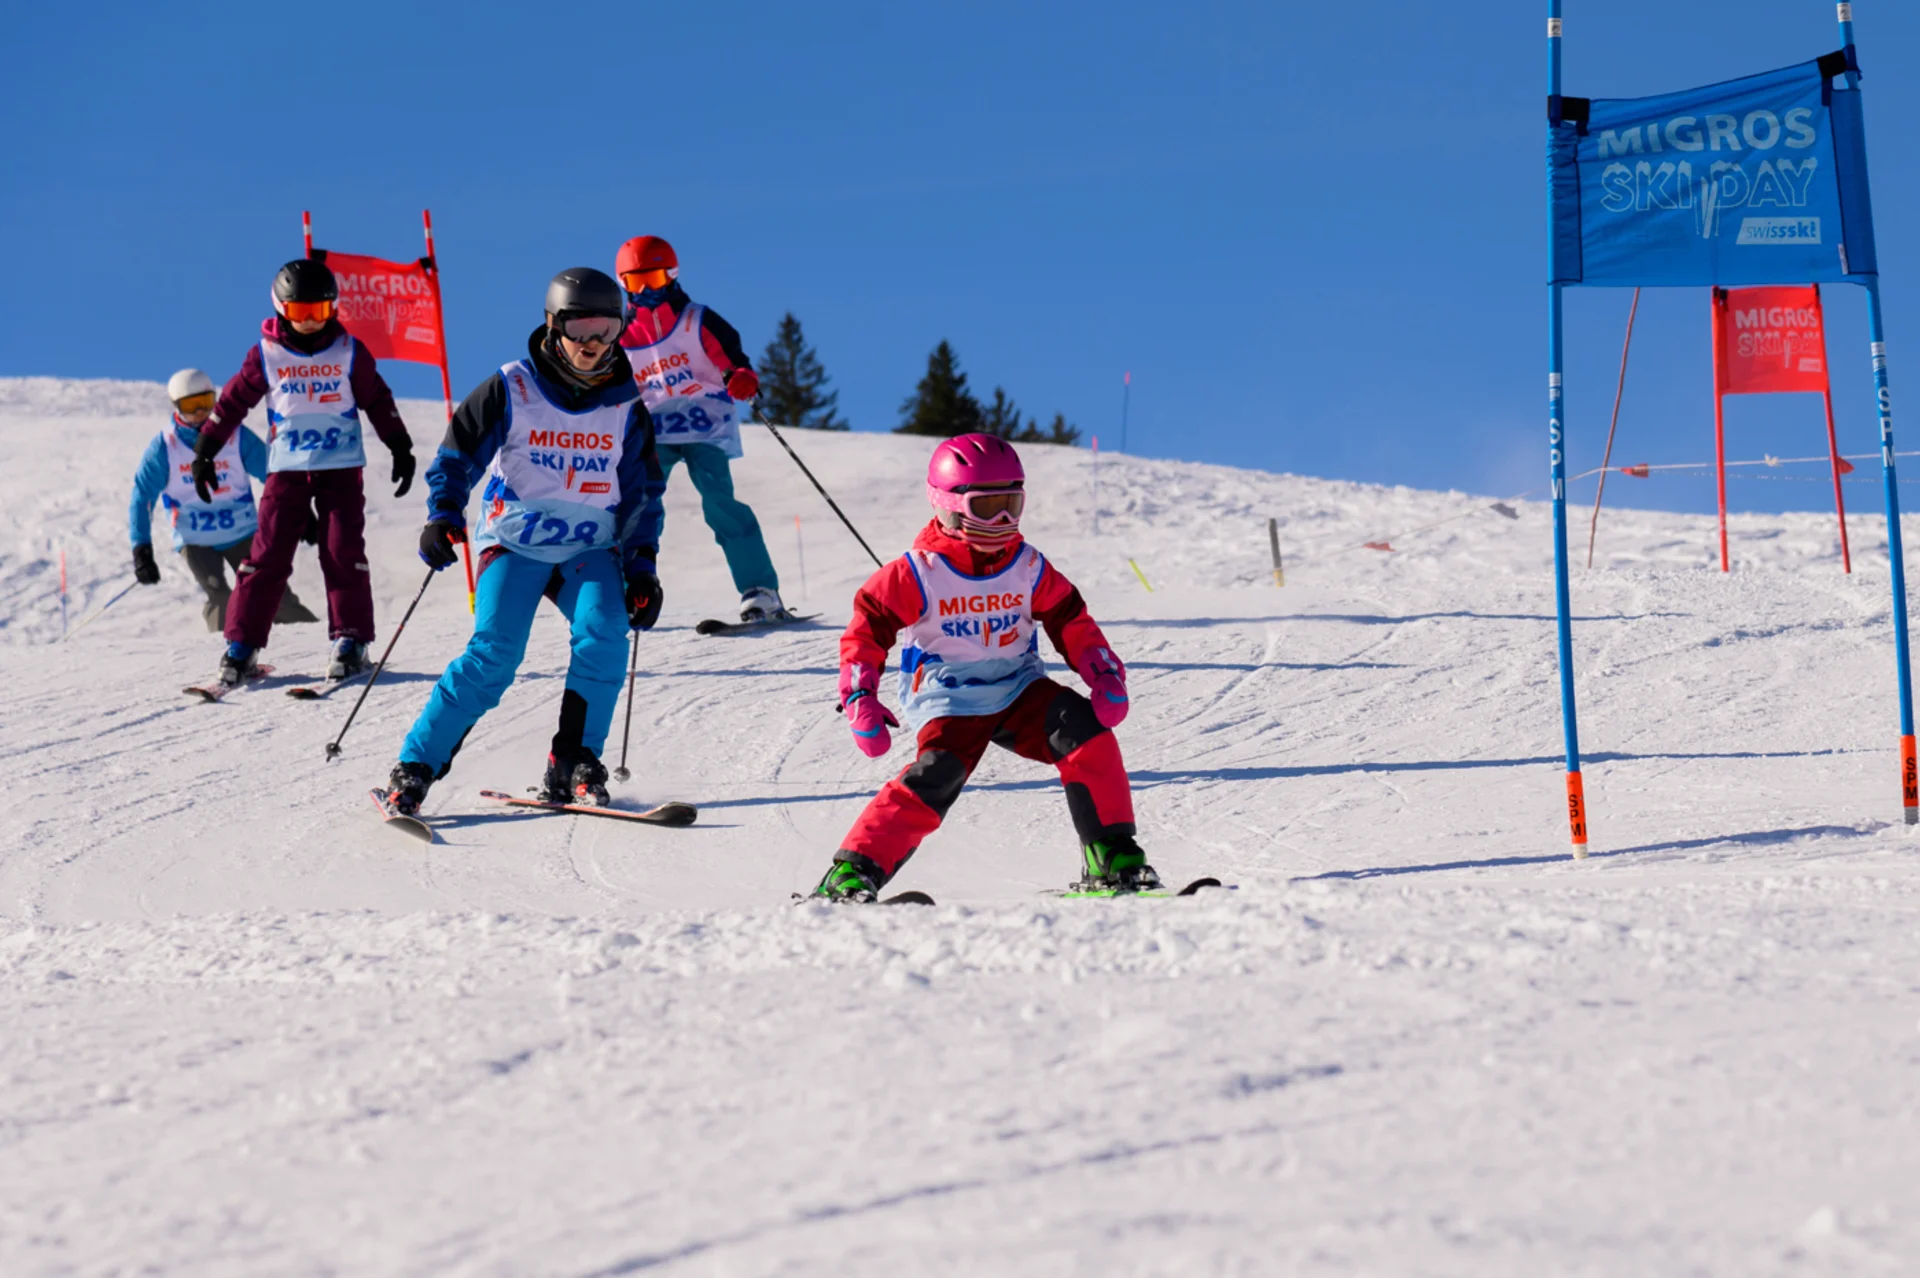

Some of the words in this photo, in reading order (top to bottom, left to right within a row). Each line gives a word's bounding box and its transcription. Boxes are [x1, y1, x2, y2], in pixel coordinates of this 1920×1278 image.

[1597, 107, 1817, 158] MIGROS
[1601, 160, 1694, 212] SKI
[1709, 157, 1818, 209] DAY
[334, 271, 431, 297] MIGROS
[337, 295, 385, 322] SKI
[1735, 307, 1818, 329] MIGROS
[1737, 331, 1781, 357] SKI
[277, 364, 342, 380] MIGROS
[634, 352, 690, 384] MIGROS
[665, 369, 694, 387] DAY
[280, 380, 306, 394] SKI
[312, 379, 342, 393] DAY
[651, 406, 713, 435] 128
[287, 427, 342, 452] 128
[528, 429, 613, 451] MIGROS
[529, 449, 565, 471] SKI
[571, 452, 612, 472] DAY
[189, 508, 236, 531] 128
[517, 511, 599, 546] 128
[939, 592, 1025, 617] MIGROS
[941, 616, 980, 637] SKI
[1906, 756, 1918, 800] SPM
